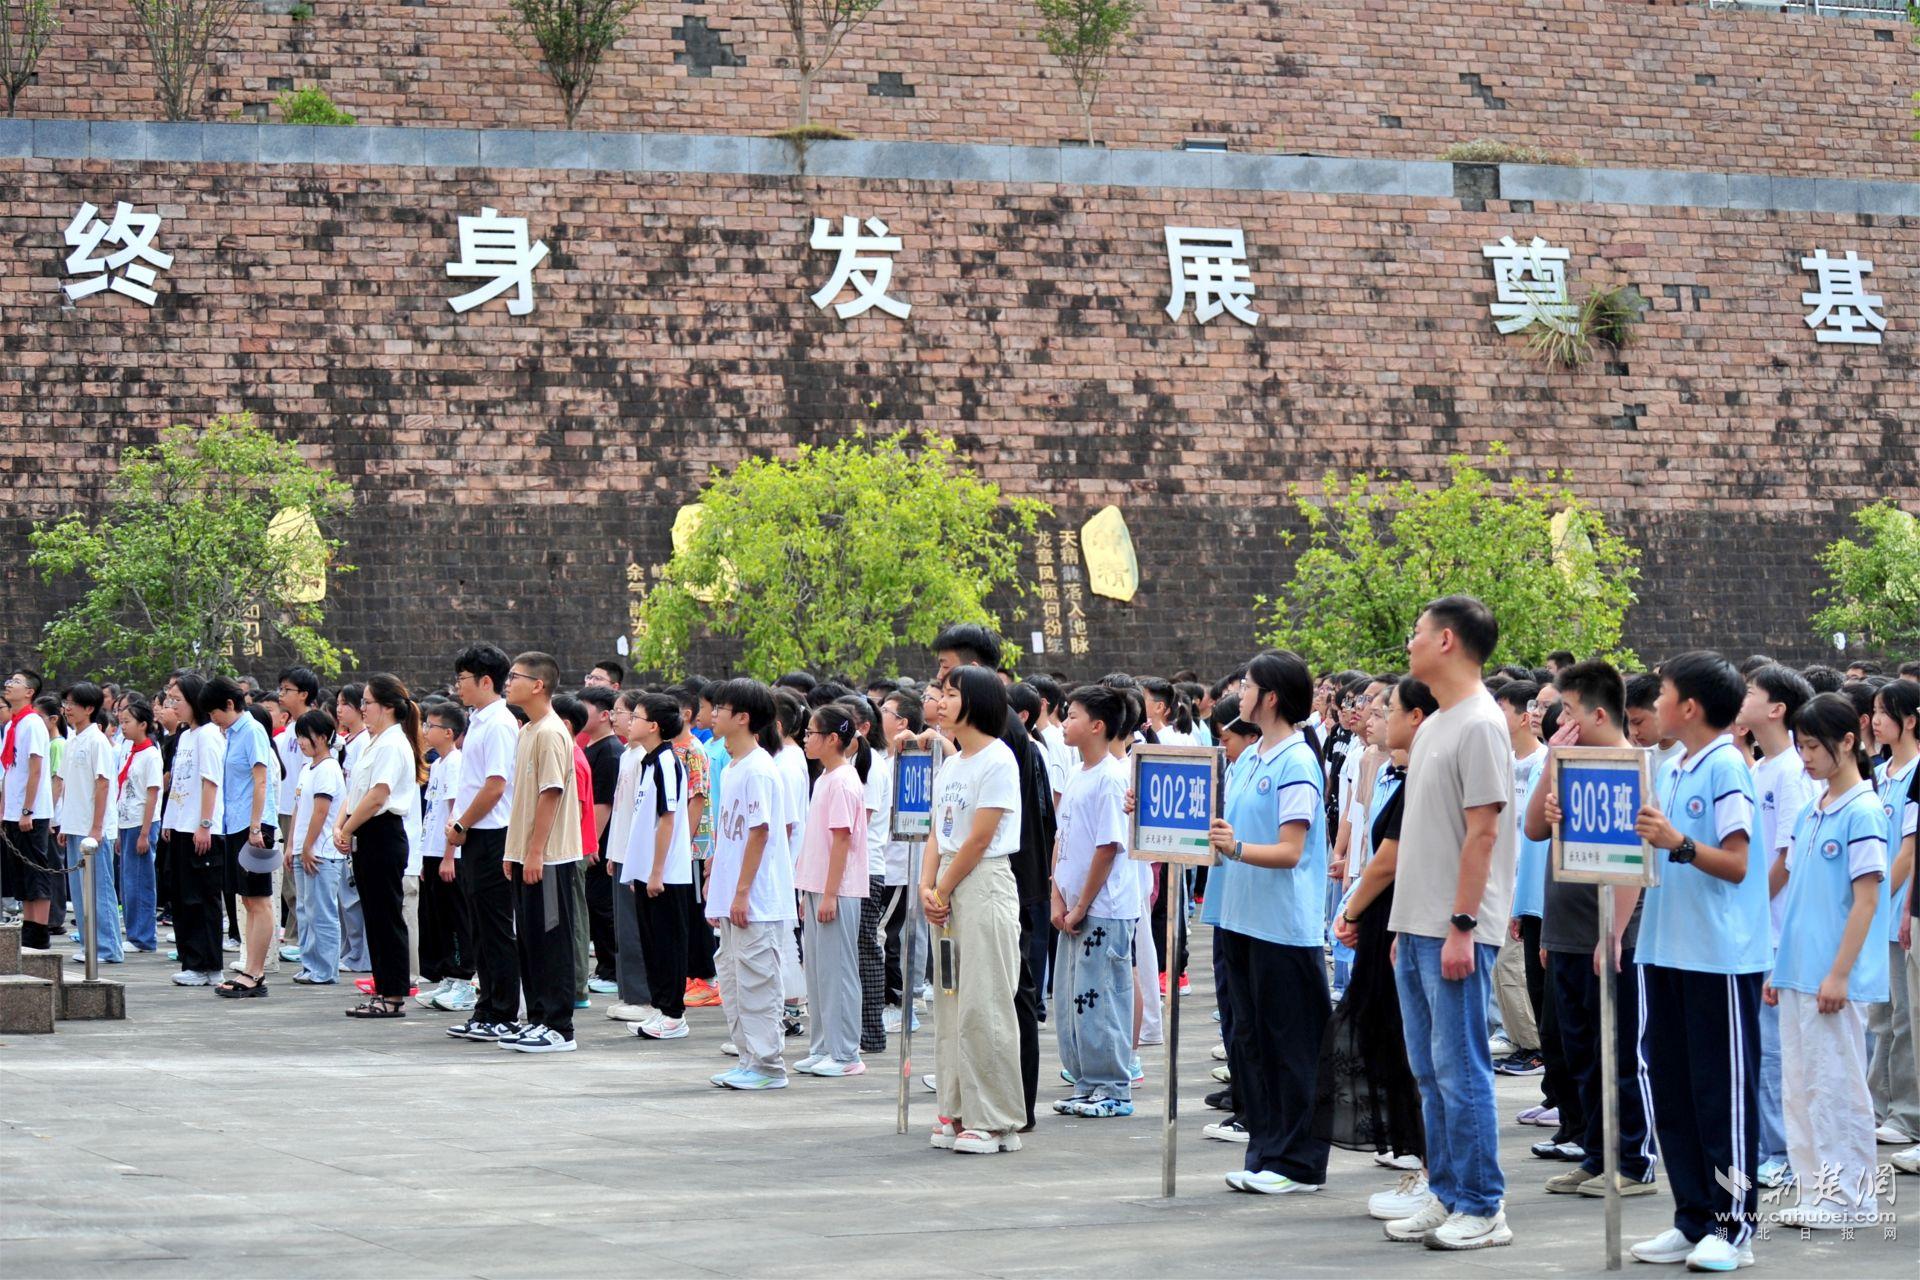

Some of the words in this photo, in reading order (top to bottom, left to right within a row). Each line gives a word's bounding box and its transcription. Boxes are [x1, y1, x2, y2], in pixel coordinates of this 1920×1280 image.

[904, 765, 932, 804] 901班
[1150, 774, 1206, 819] 902班
[1571, 781, 1634, 834] 903班
